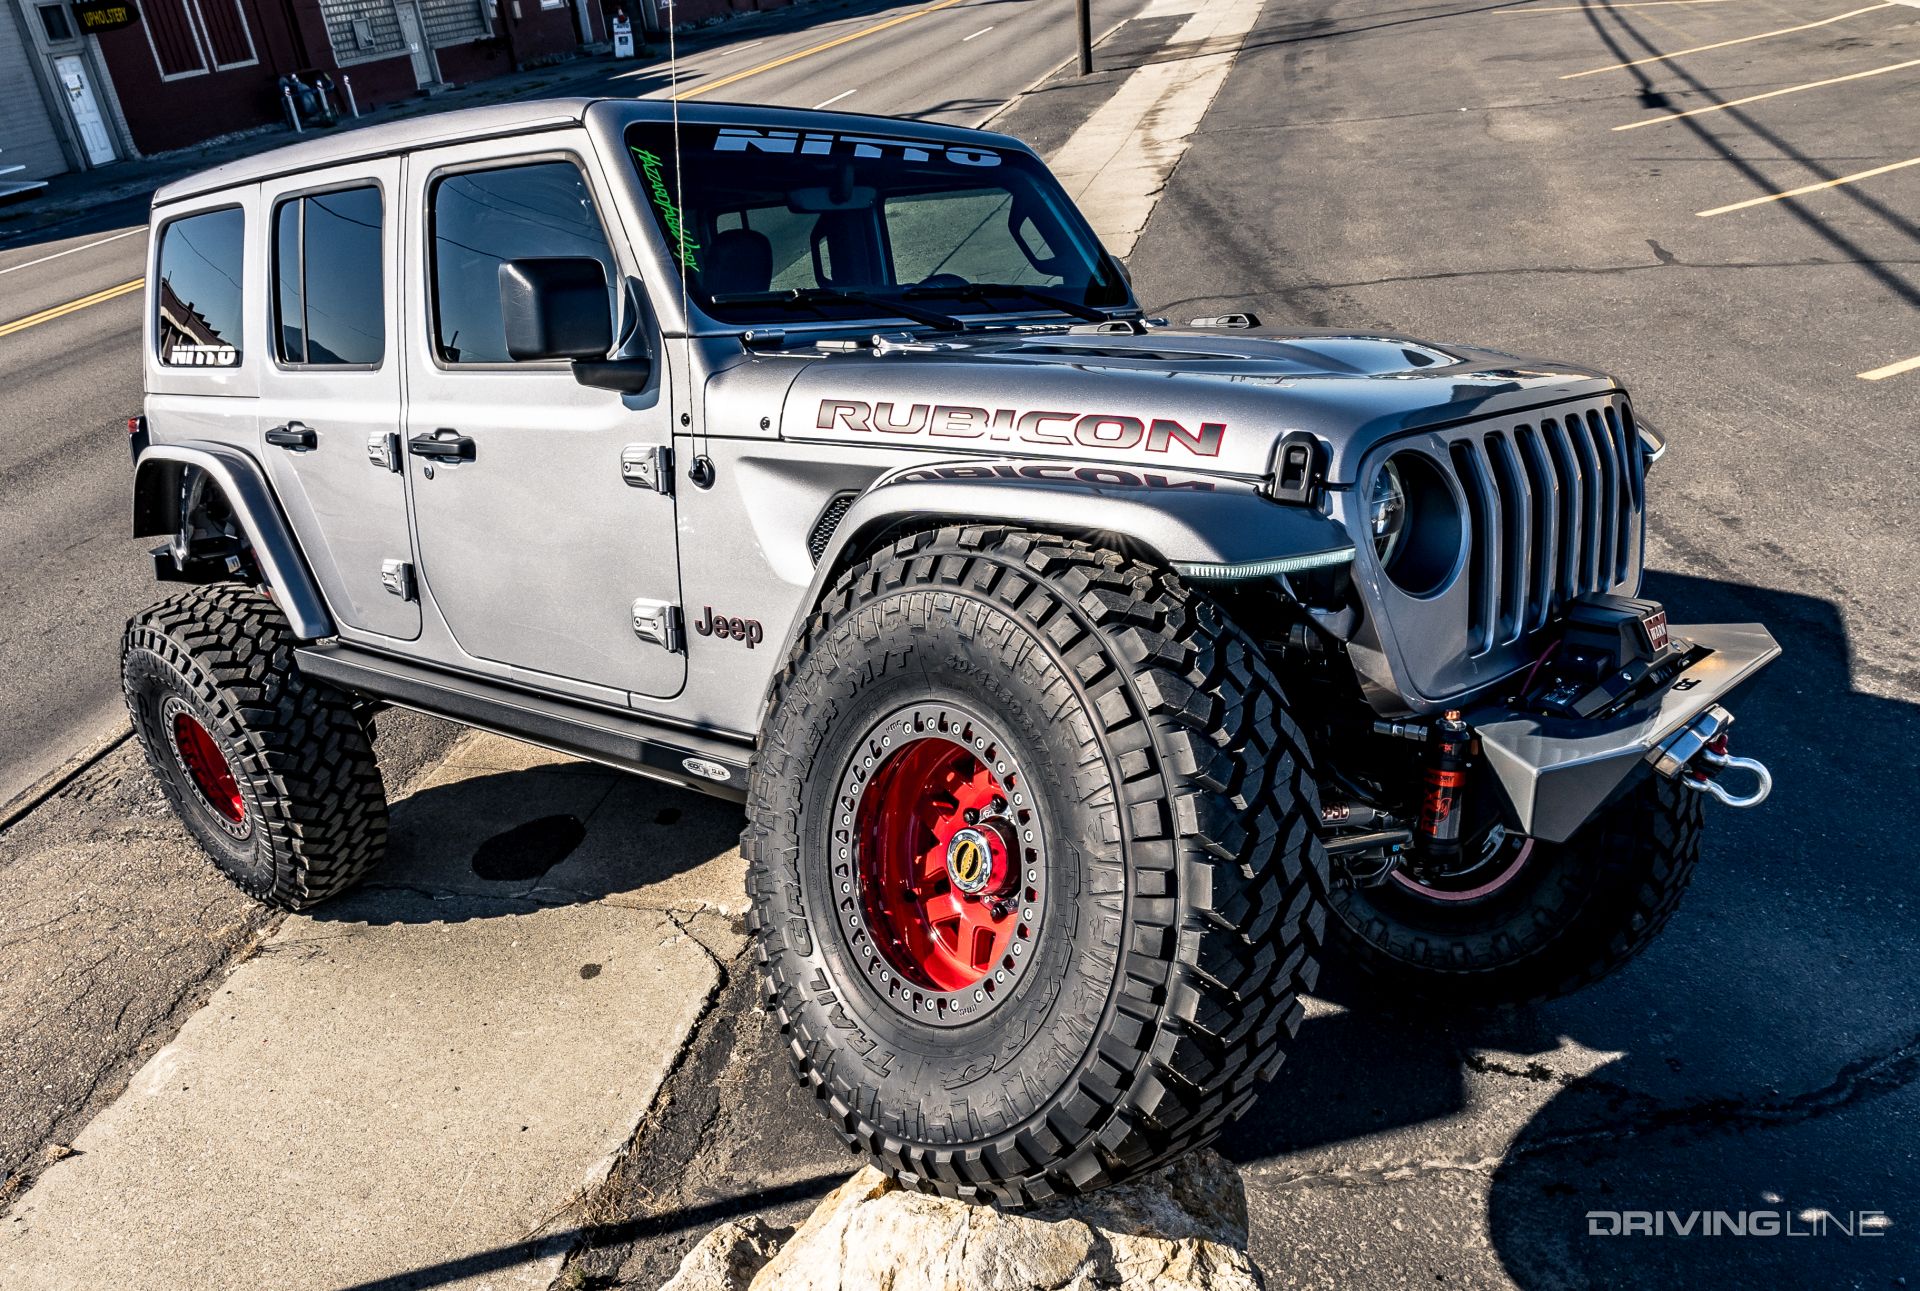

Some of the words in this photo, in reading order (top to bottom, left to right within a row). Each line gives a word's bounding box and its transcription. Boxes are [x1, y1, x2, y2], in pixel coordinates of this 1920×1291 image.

[83, 7, 128, 27] UPHOLSTERY
[713, 128, 1002, 167] NITTO
[170, 344, 236, 365] NITTO
[816, 399, 1227, 457] RUBICON
[694, 605, 764, 649] Jeep
[1649, 623, 1667, 641] WARN
[810, 967, 896, 1078] TRAIL
